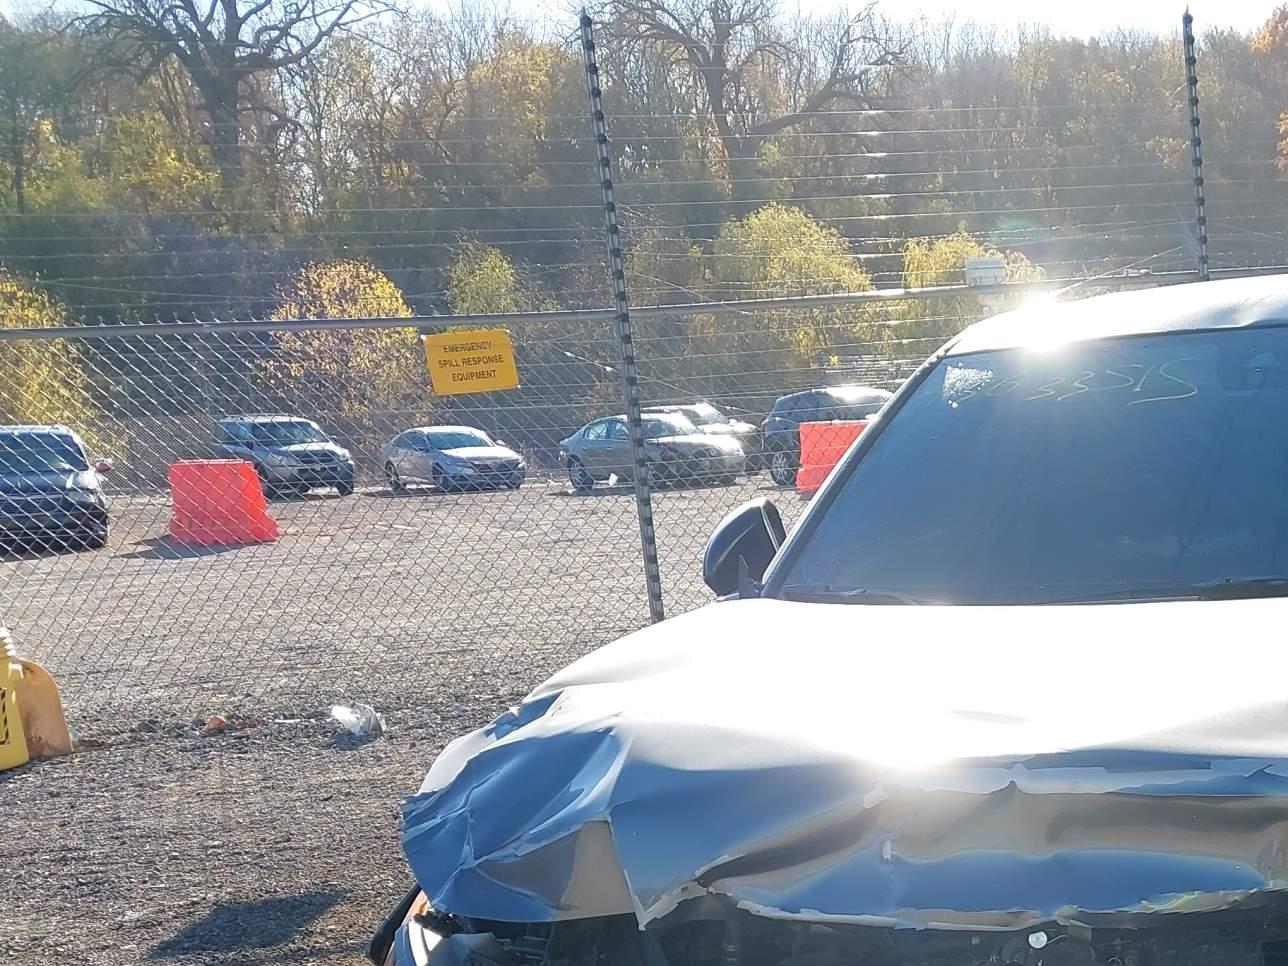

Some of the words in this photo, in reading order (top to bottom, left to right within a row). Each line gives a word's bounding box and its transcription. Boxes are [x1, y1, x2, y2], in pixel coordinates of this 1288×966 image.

[443, 340, 492, 353] EMERGENCY
[438, 358, 460, 368] SPILL
[462, 354, 504, 367] RESPONSE
[451, 369, 497, 382] EQUIPMENT
